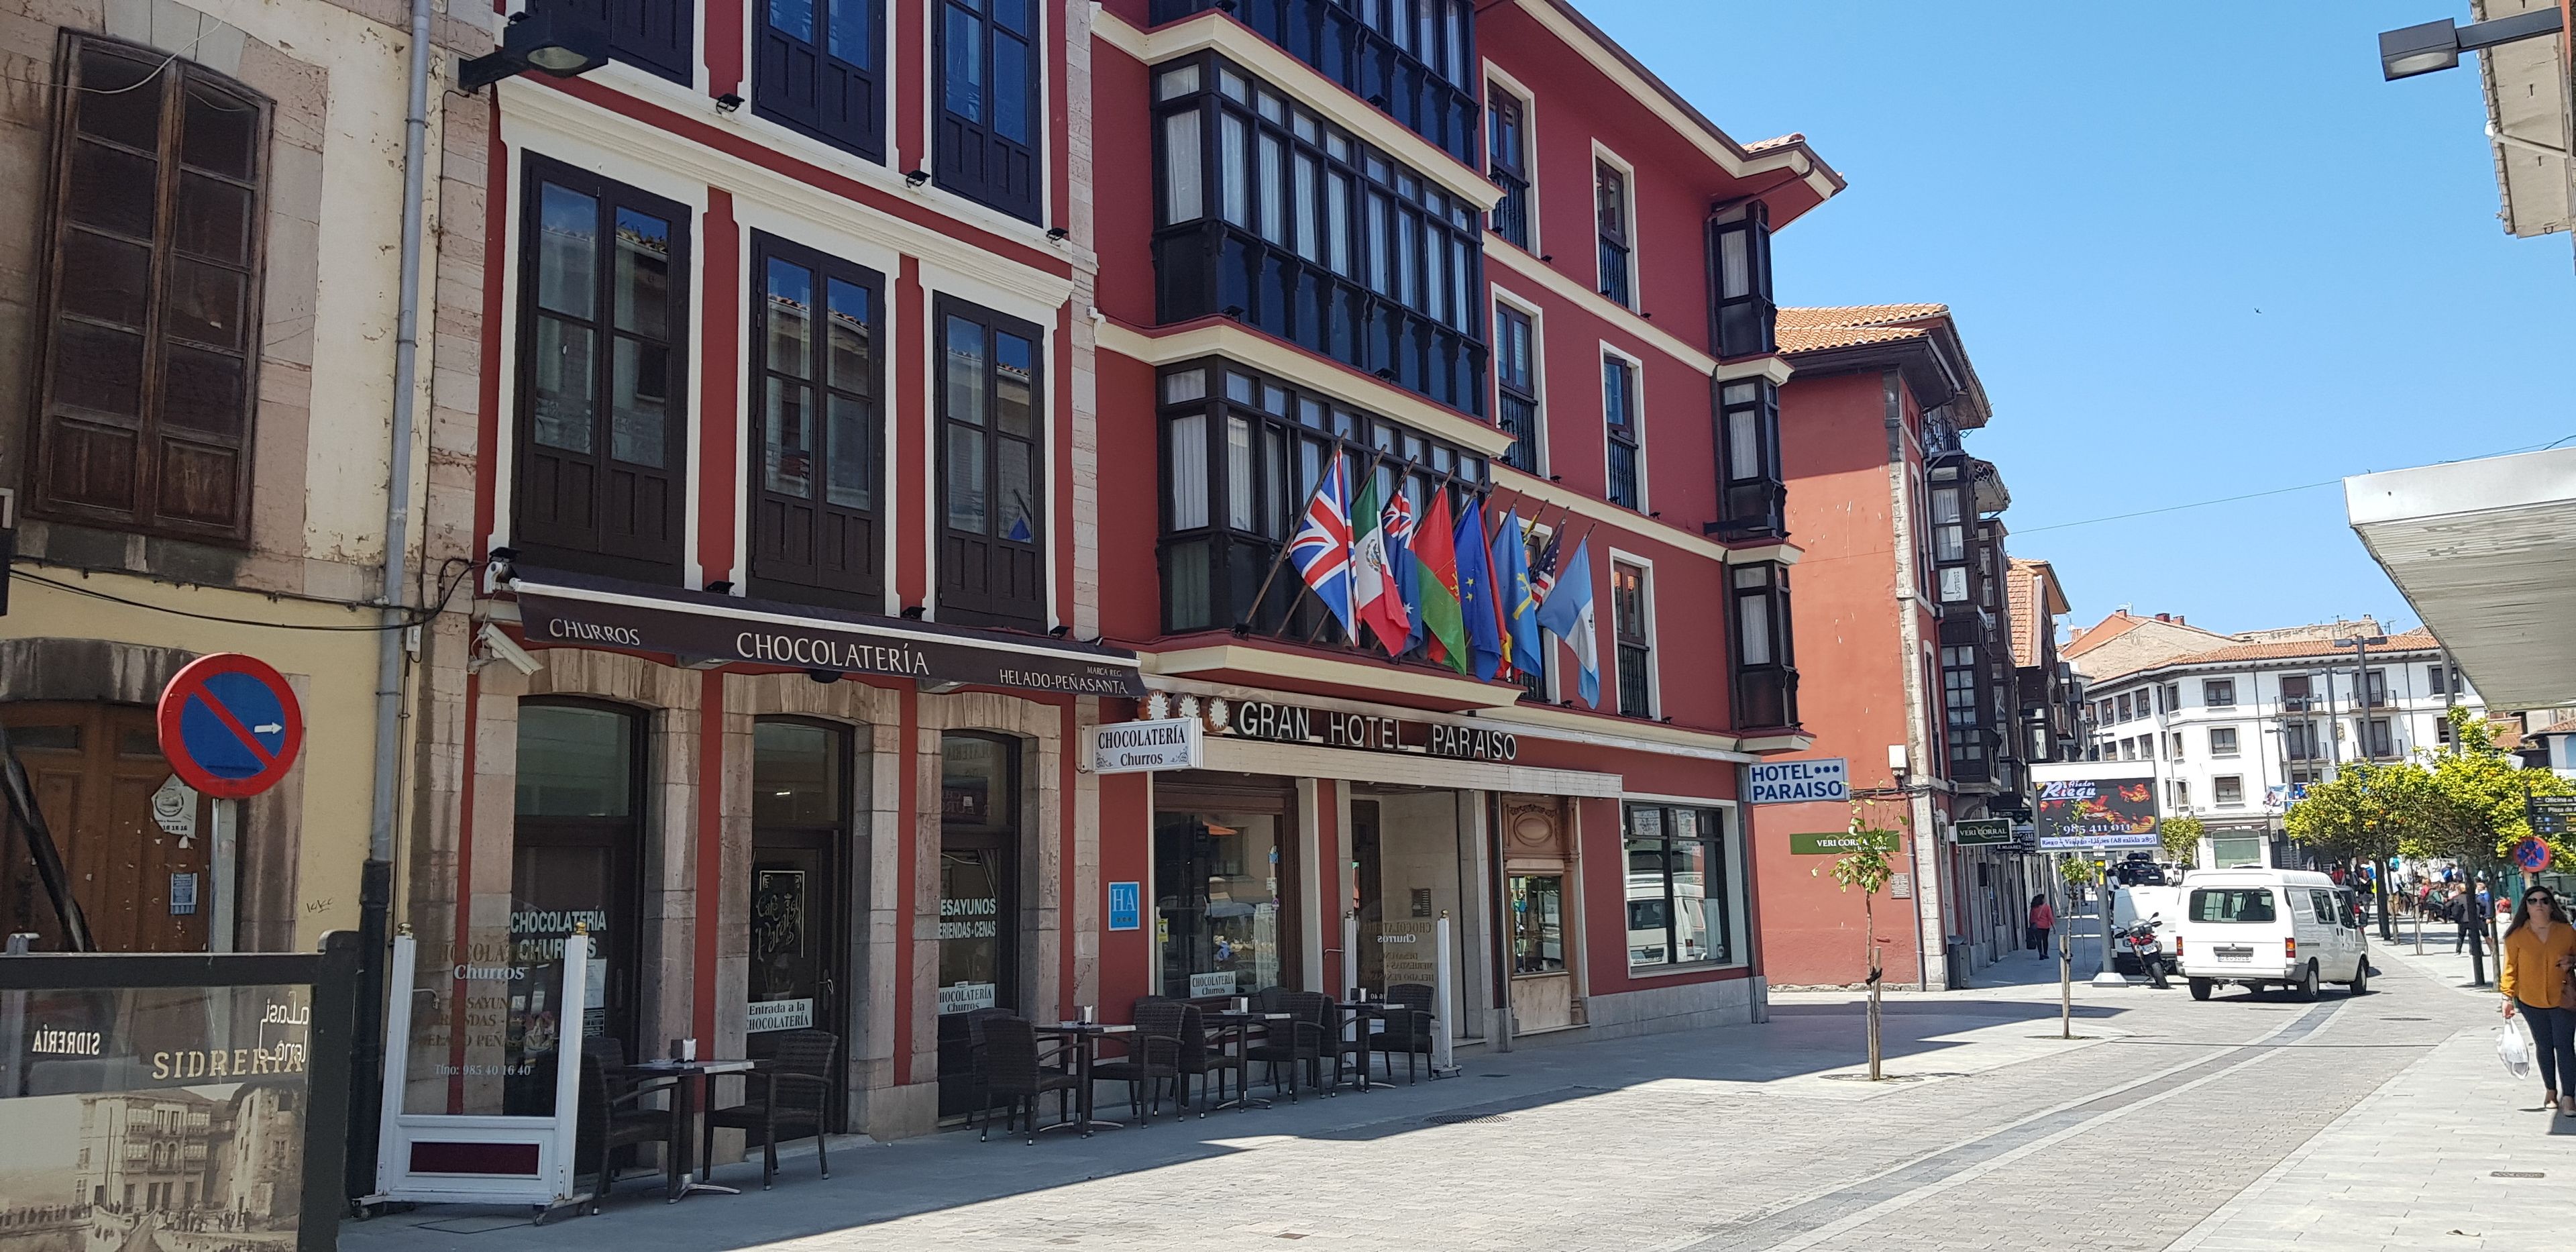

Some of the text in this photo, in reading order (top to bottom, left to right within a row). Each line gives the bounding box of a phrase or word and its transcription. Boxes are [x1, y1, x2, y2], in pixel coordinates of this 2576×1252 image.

[549, 618, 640, 645] CHURROS
[737, 632, 930, 676] CHOCOLATERÍA
[1087, 666, 1107, 676] MARCA
[1000, 669, 1128, 694] HELADO-PEÑASANTA
[1098, 725, 1185, 749] CHOCOLATERÍA
[1239, 700, 1517, 761] GRAN HOTEL PARAISO
[1120, 752, 1163, 767] Churros
[1752, 764, 1814, 782] HOTEL
[1753, 780, 1843, 801] PARAISO
[2040, 781, 2096, 802] Riegu
[2088, 825, 2107, 834] 411
[1817, 839, 1837, 847] VERI
[941, 898, 996, 916] ESAYUNOS
[1112, 888, 1136, 912] HA
[519, 937, 596, 960] CHURS
[453, 965, 525, 980] Churros
[939, 986, 991, 1003] HOCOLATERÍA
[749, 1003, 785, 1015] Entrada
[797, 1002, 805, 1011] la
[947, 1003, 979, 1012] Churros
[463, 1065, 482, 1075] 985
[486, 1065, 498, 1075] 40
[503, 1065, 514, 1075] 16
[518, 1065, 531, 1075] 40
